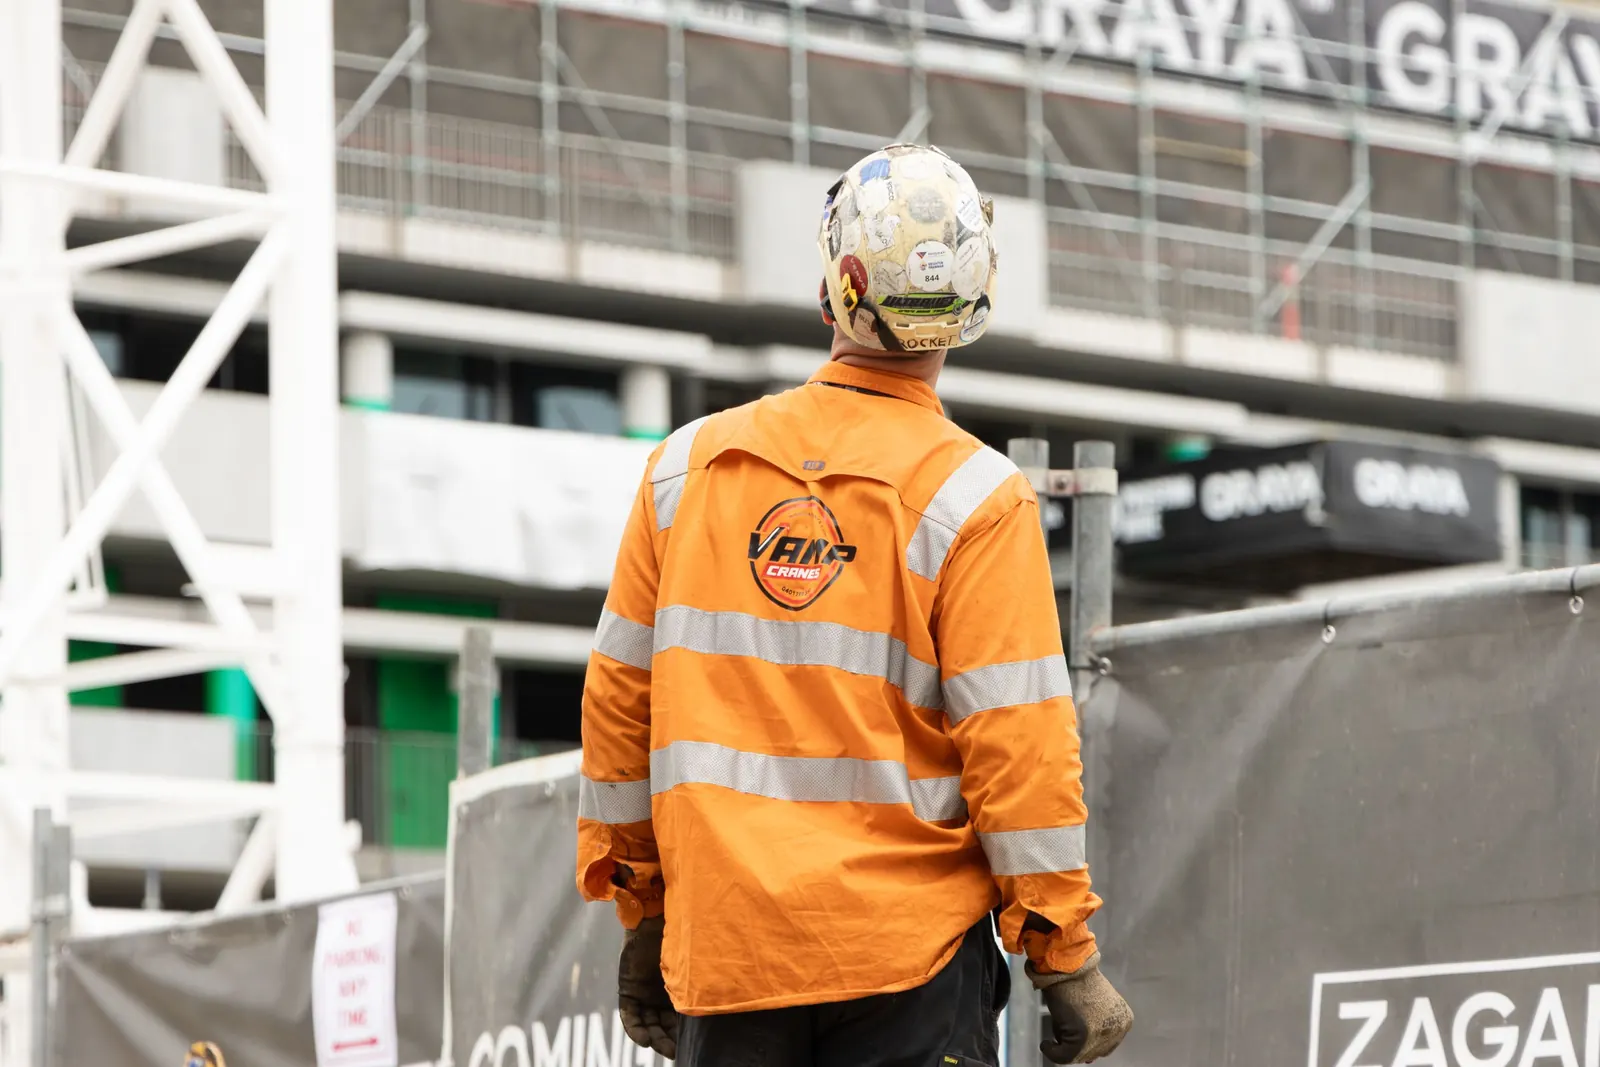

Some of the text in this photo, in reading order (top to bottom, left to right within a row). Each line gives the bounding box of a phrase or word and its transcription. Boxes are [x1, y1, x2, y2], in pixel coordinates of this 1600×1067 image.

[924, 274, 940, 282] 844
[748, 526, 857, 565] VAMP
[766, 565, 820, 580] CRANES
